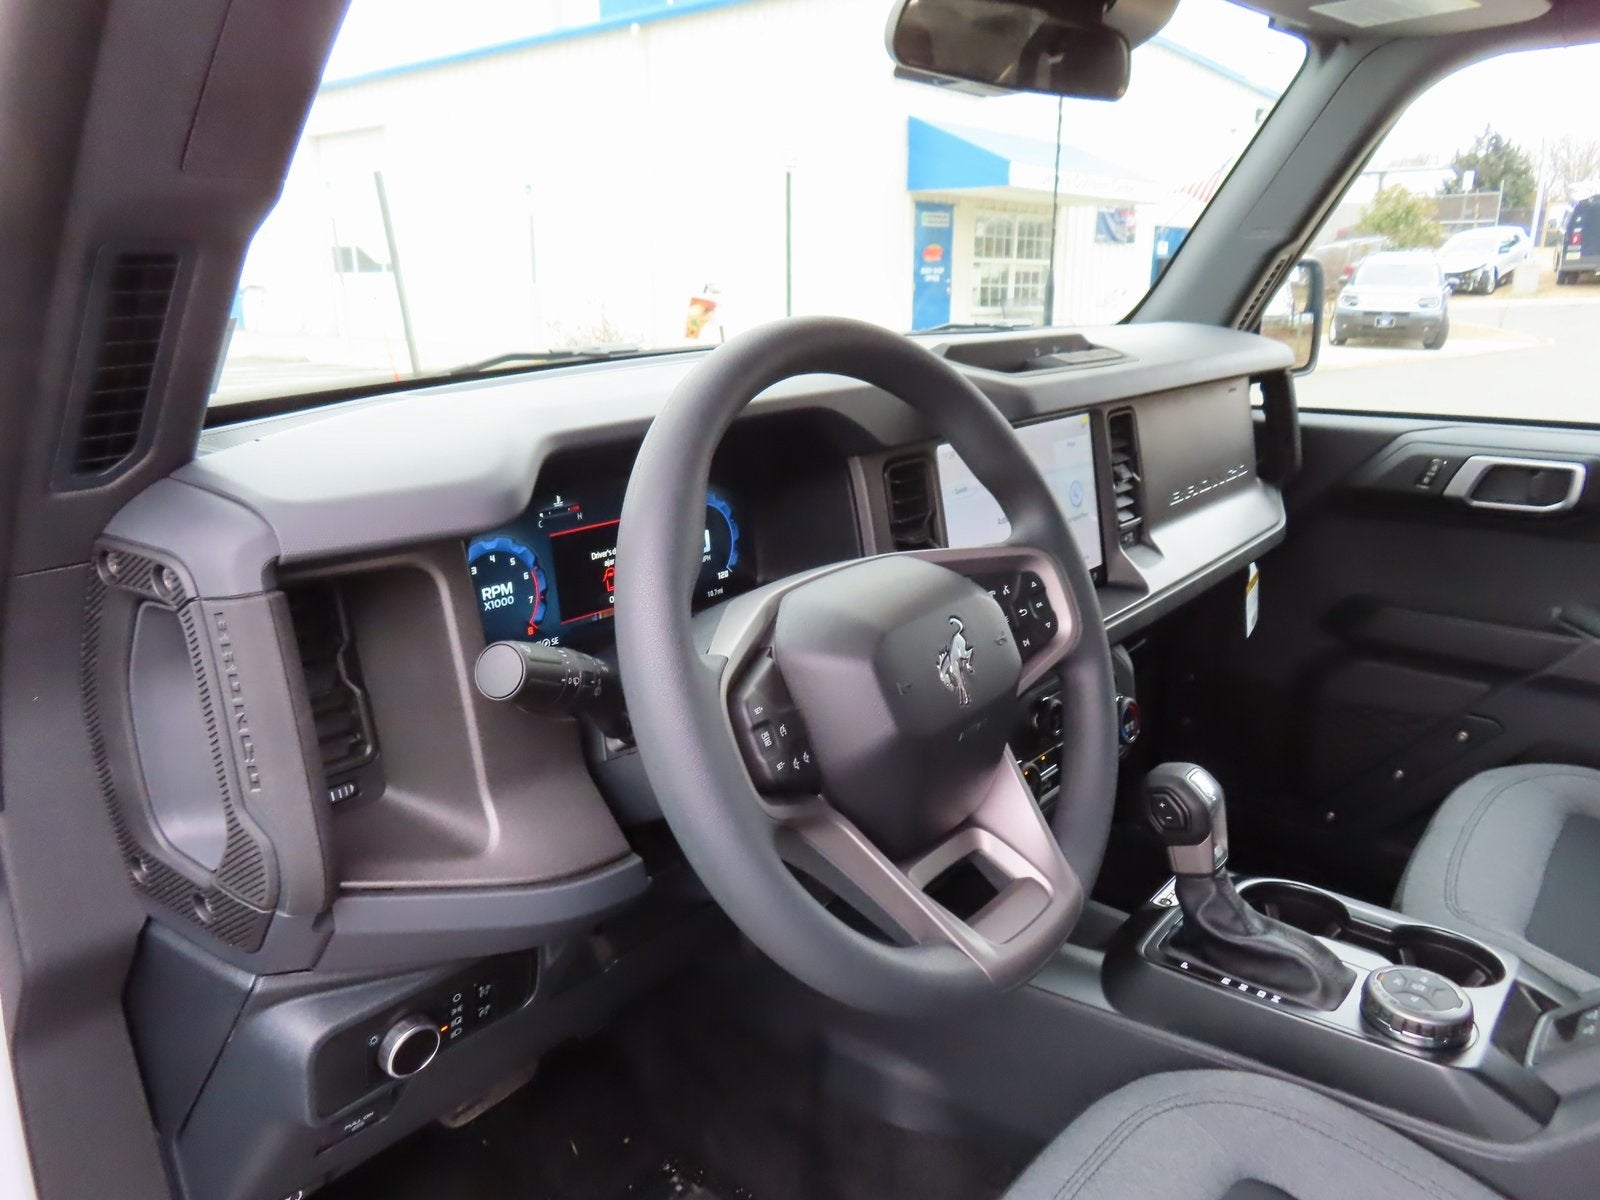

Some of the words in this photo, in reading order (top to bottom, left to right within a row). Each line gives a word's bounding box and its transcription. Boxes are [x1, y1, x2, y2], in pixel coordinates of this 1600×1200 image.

[489, 554, 496, 563] 4
[509, 557, 516, 566] 5
[470, 566, 478, 575] 3
[717, 570, 729, 580] 120
[523, 571, 530, 580] 6
[481, 581, 513, 601] RPM
[528, 595, 534, 604] 7
[527, 626, 534, 636] 8
[551, 636, 560, 646] SE
[213, 611, 262, 793] BRONCO
[1180, 961, 1189, 970] P
